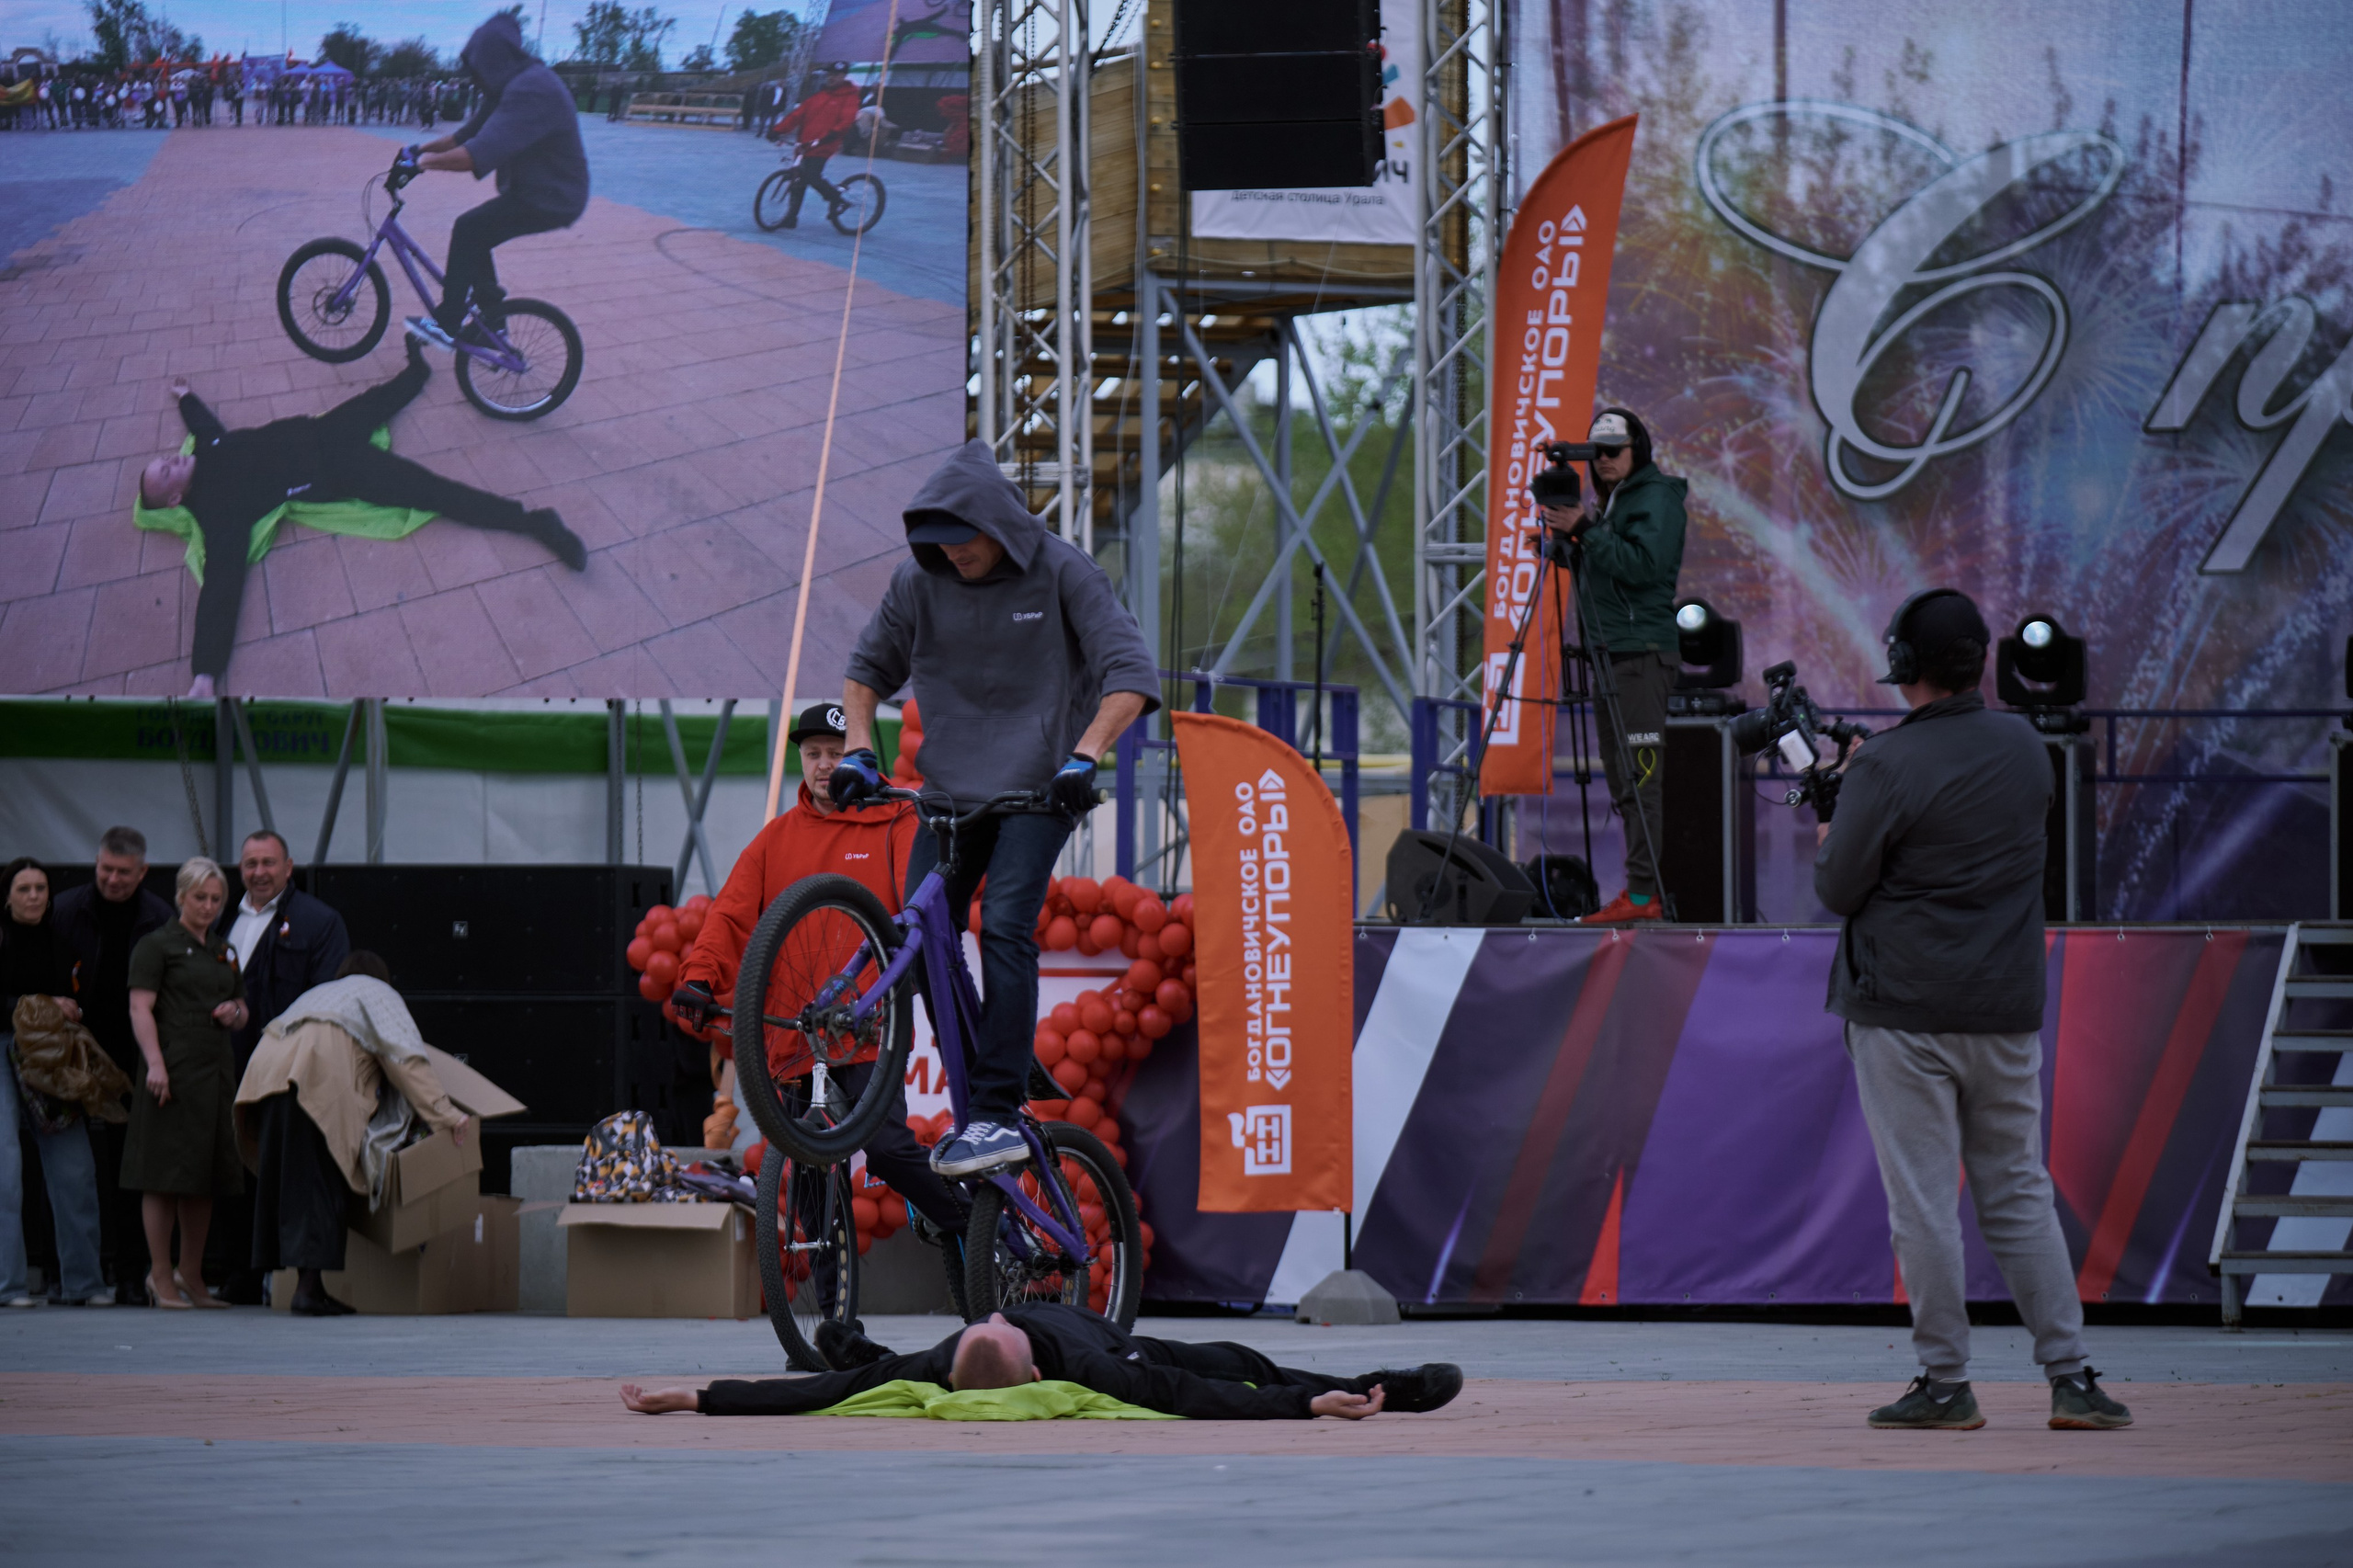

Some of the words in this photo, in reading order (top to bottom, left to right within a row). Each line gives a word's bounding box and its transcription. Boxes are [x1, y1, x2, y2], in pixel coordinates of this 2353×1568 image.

[1287, 191, 1340, 205] столица
[1345, 191, 1385, 206] Урала
[1493, 309, 1543, 619] БОГДАНОВИЧСКОЕ
[1531, 220, 1555, 290] ОАО
[1234, 781, 1256, 835] ОАО
[1240, 848, 1262, 1082] БОГДАНОВИЧСКОЕ
[1259, 791, 1291, 1068] ОГНЕУПОРЫ
